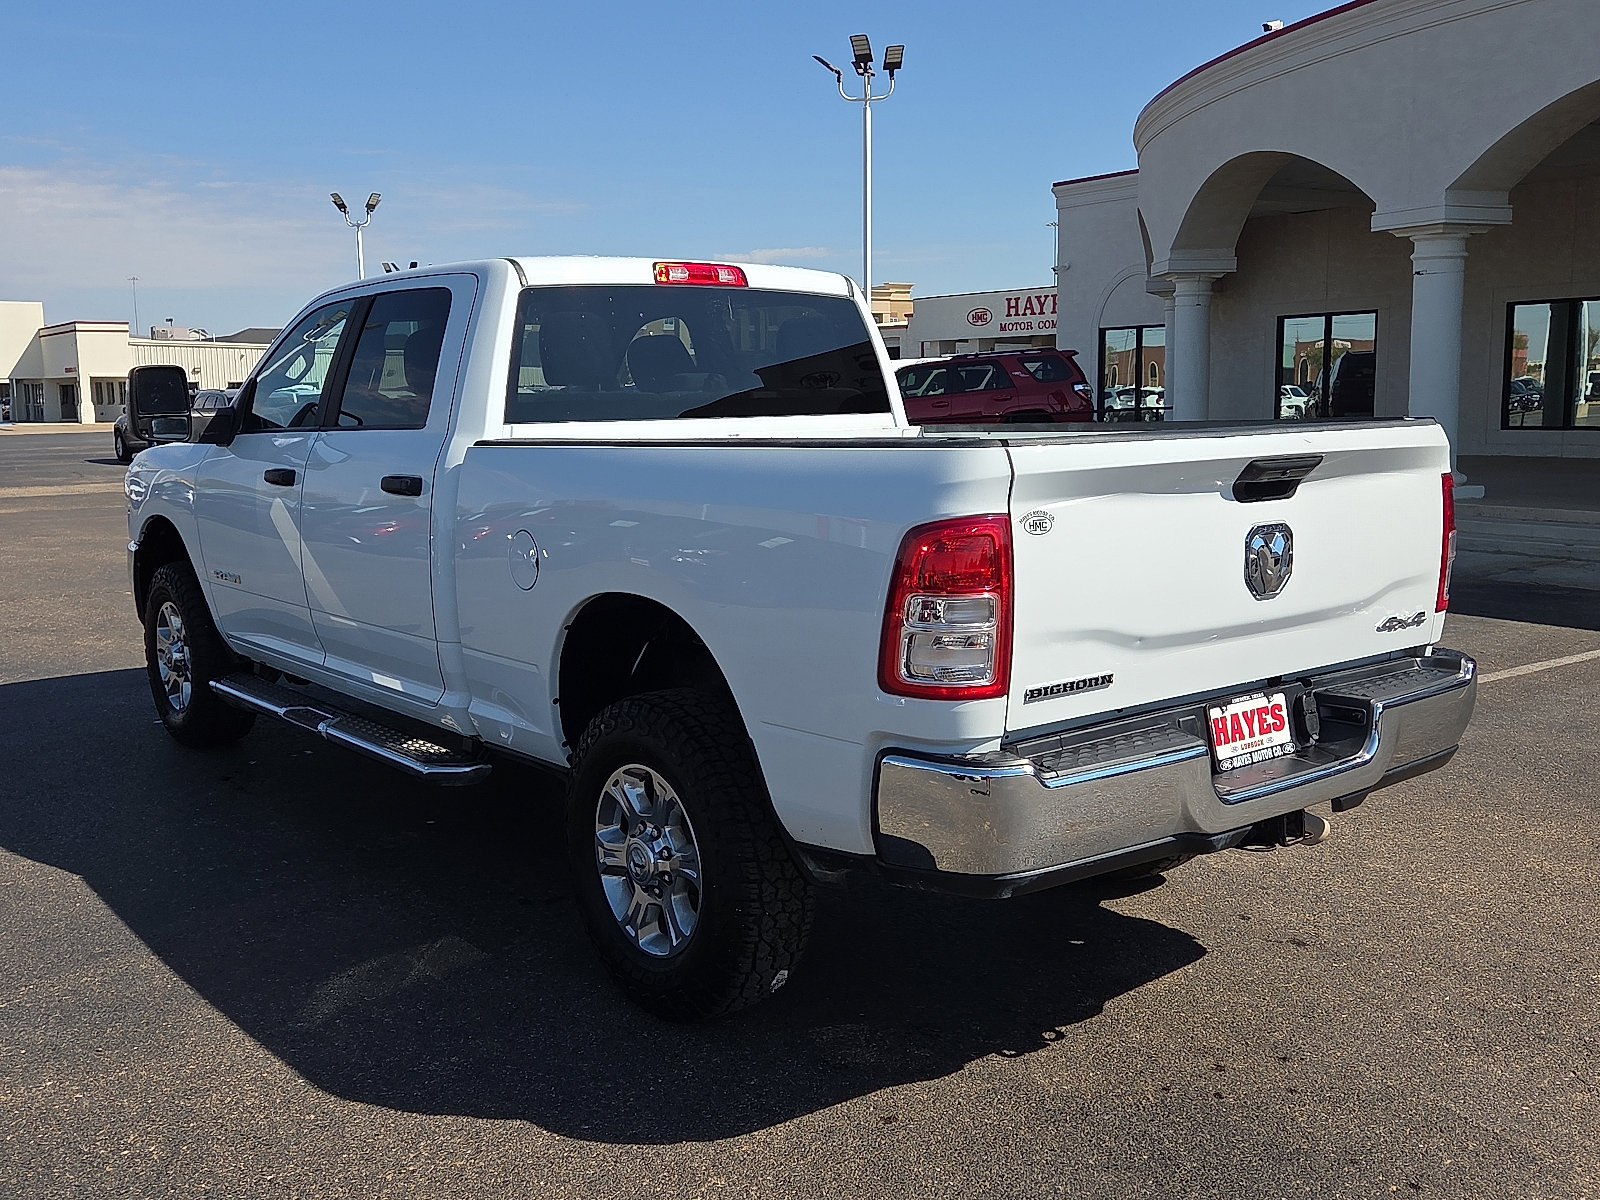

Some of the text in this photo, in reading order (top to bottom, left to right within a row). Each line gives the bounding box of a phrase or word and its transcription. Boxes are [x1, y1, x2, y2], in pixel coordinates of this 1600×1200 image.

[999, 321, 1034, 332] MOTOR
[1028, 518, 1048, 532] HMC
[1212, 703, 1286, 747] HAYES
[1233, 753, 1252, 768] HAYES
[1251, 747, 1274, 762] MOTOR
